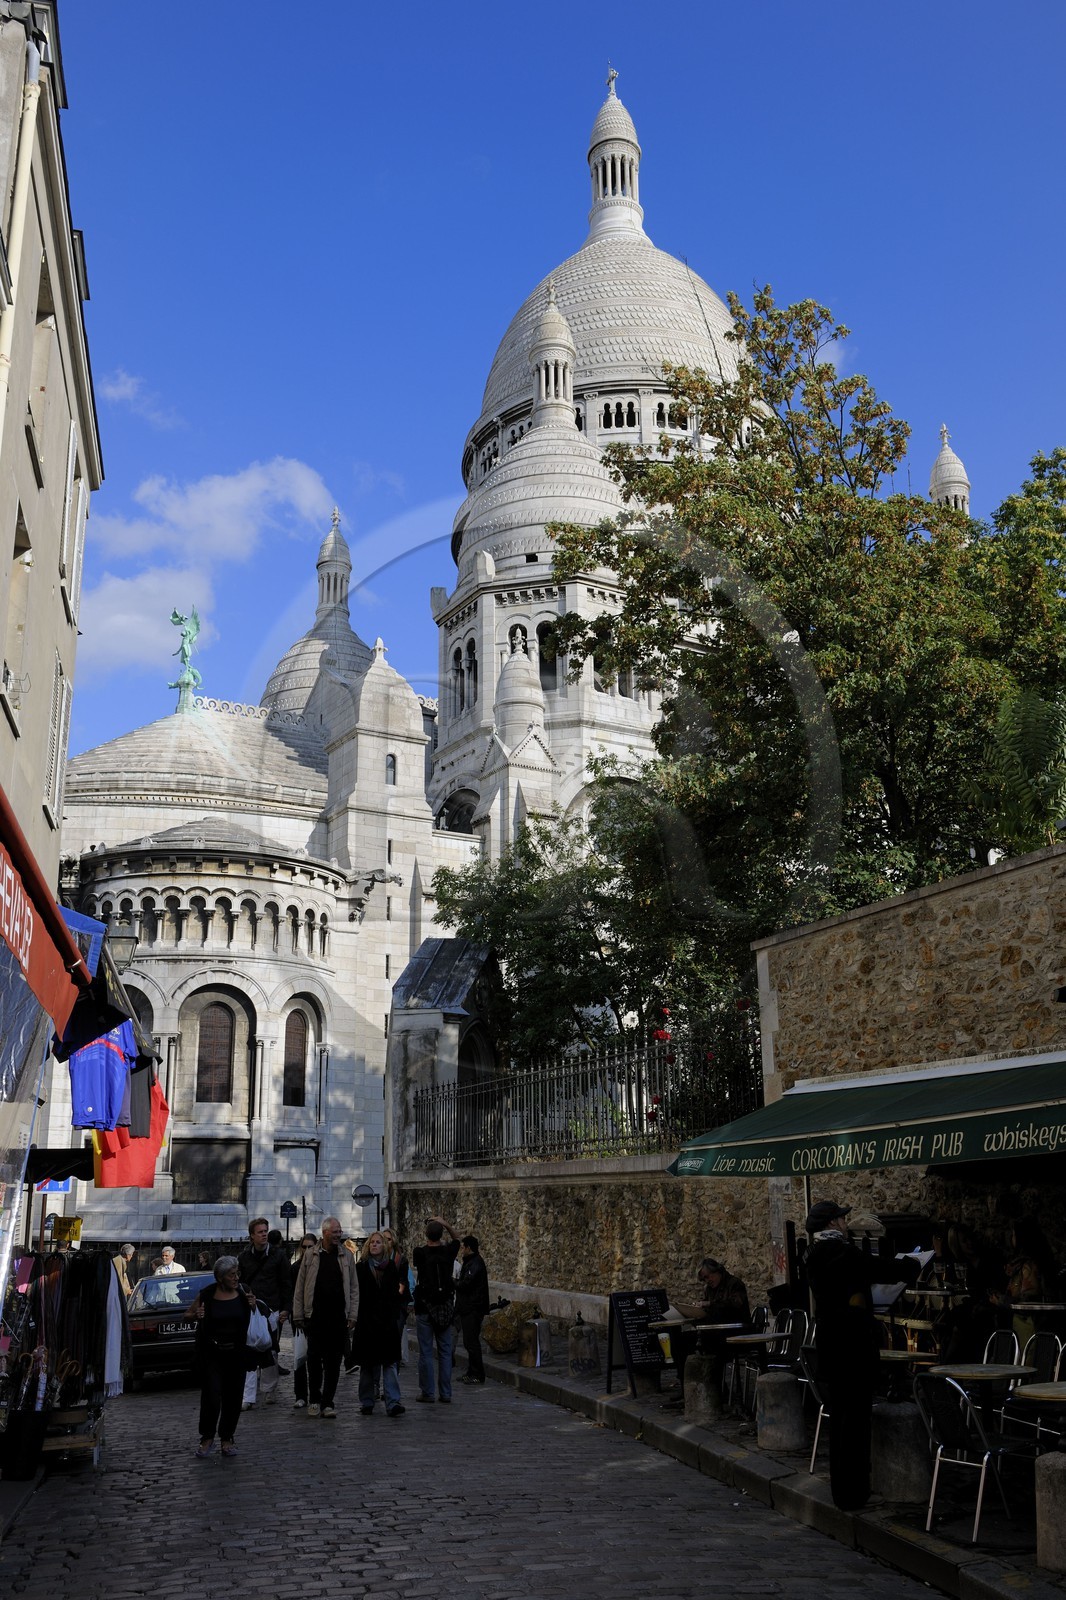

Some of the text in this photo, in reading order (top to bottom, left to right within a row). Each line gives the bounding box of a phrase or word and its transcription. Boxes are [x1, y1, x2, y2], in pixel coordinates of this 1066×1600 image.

[983, 1123, 1066, 1151] whiskeys
[712, 1152, 776, 1172] Live music
[791, 1132, 964, 1172] CORCORAN'S IRISH PUB
[162, 1323, 176, 1332] 142
